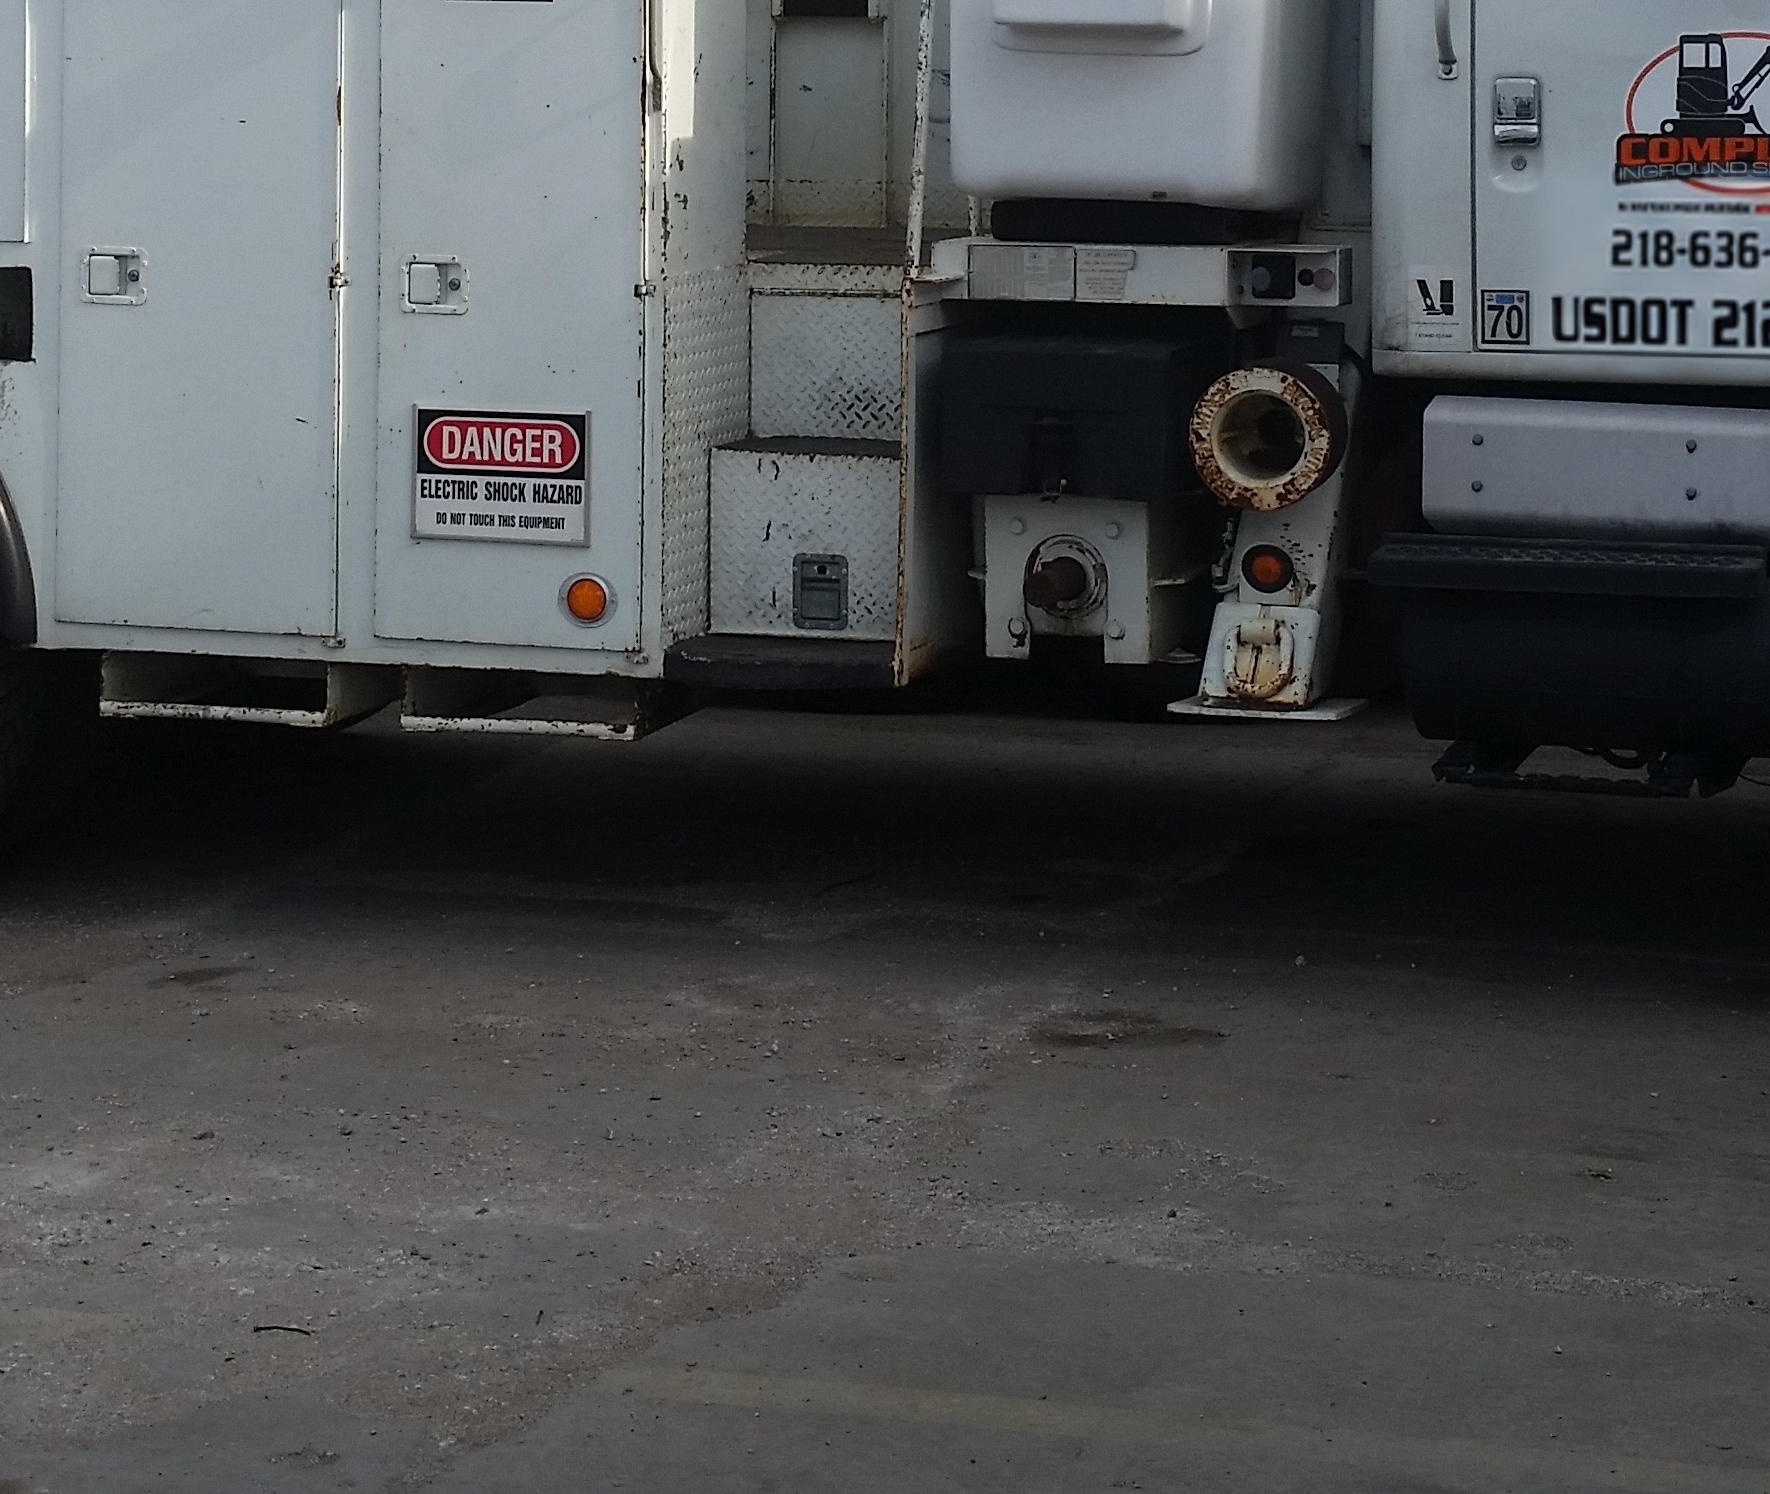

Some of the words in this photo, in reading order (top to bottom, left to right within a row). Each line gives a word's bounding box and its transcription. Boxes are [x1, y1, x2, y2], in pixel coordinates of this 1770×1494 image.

[1619, 161, 1749, 181] INGROUND
[1486, 304, 1524, 339] 70
[1551, 296, 1695, 346] USDOT
[441, 424, 563, 464] DANGER
[420, 478, 479, 501] ELECTRIC
[484, 481, 527, 503] SHOCK
[532, 483, 583, 506] HAZARD
[436, 511, 447, 525] DO
[450, 512, 466, 526] NOT
[469, 513, 495, 527] TOUCH
[498, 514, 516, 528] THIS
[519, 515, 565, 530] EQUIPMENT
